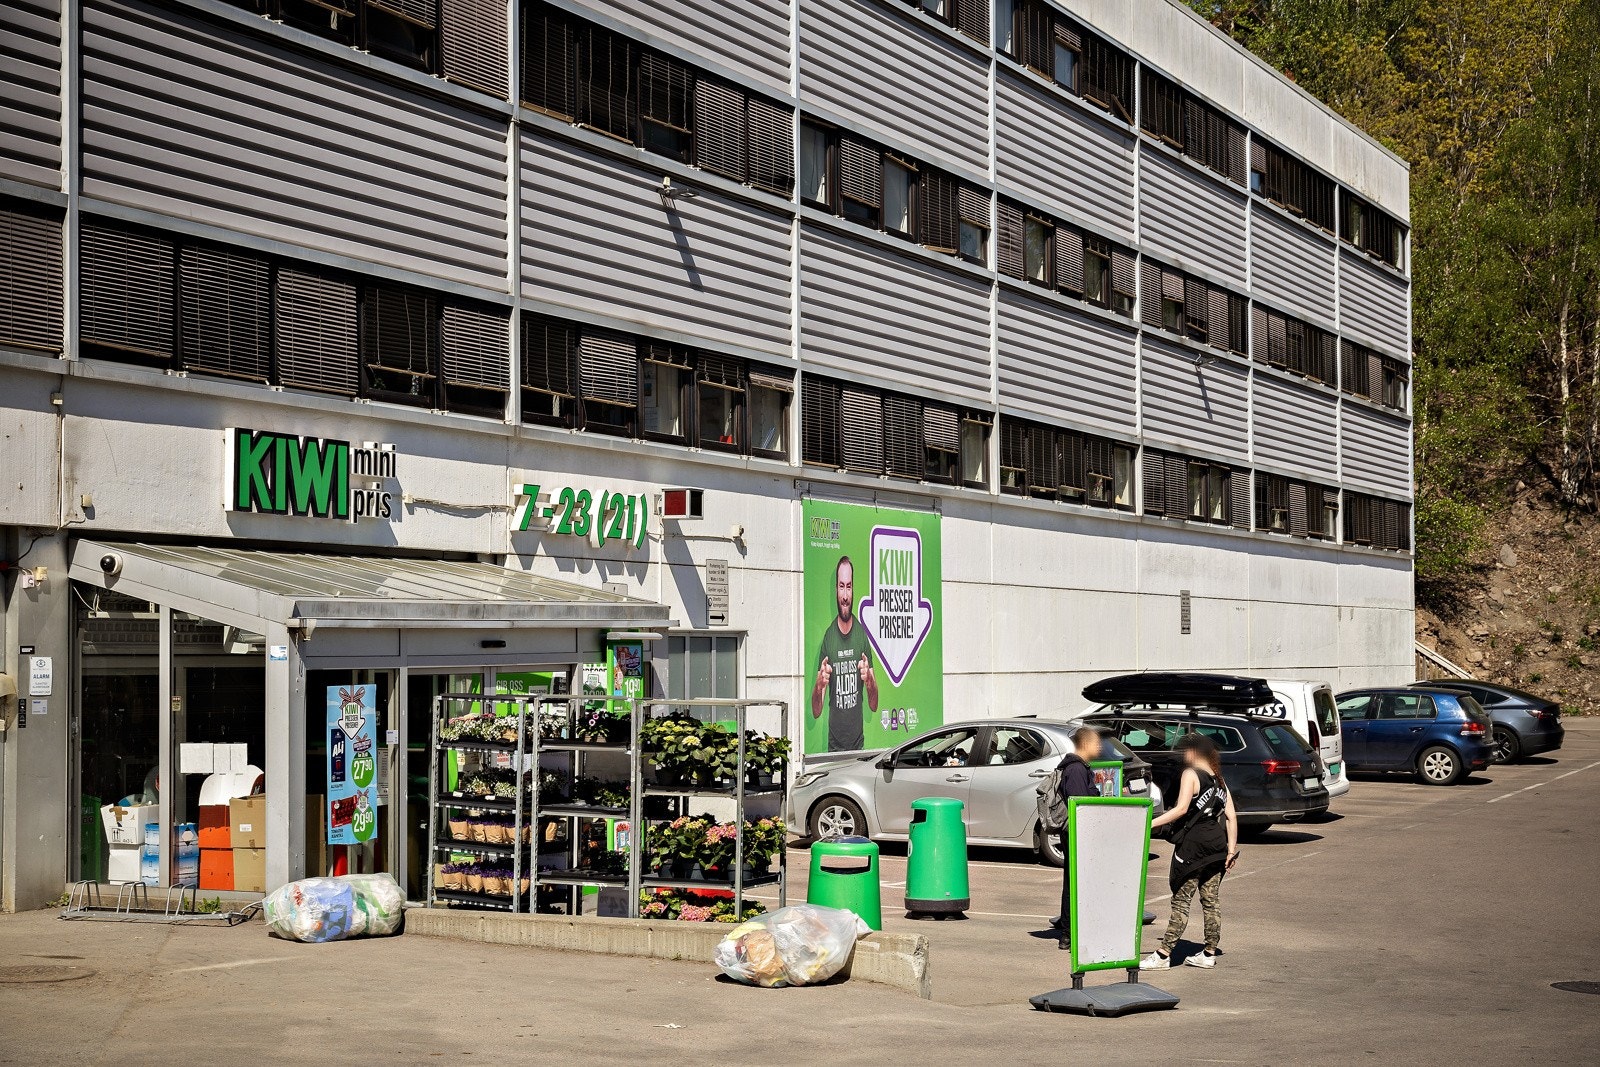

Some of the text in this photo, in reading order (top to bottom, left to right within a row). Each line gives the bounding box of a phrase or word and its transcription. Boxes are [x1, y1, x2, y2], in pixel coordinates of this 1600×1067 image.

[354, 442, 396, 478] mini
[233, 427, 350, 520] KIWI
[353, 482, 392, 524] pris
[597, 489, 648, 550] (21)
[810, 517, 831, 540] KIWI
[879, 548, 913, 587] KIWI
[879, 588, 914, 613] PRESSER
[879, 615, 914, 639] PRISENE!
[509, 680, 524, 691] OSS
[836, 673, 858, 696] ALDRI
[345, 704, 359, 715] KIWI
